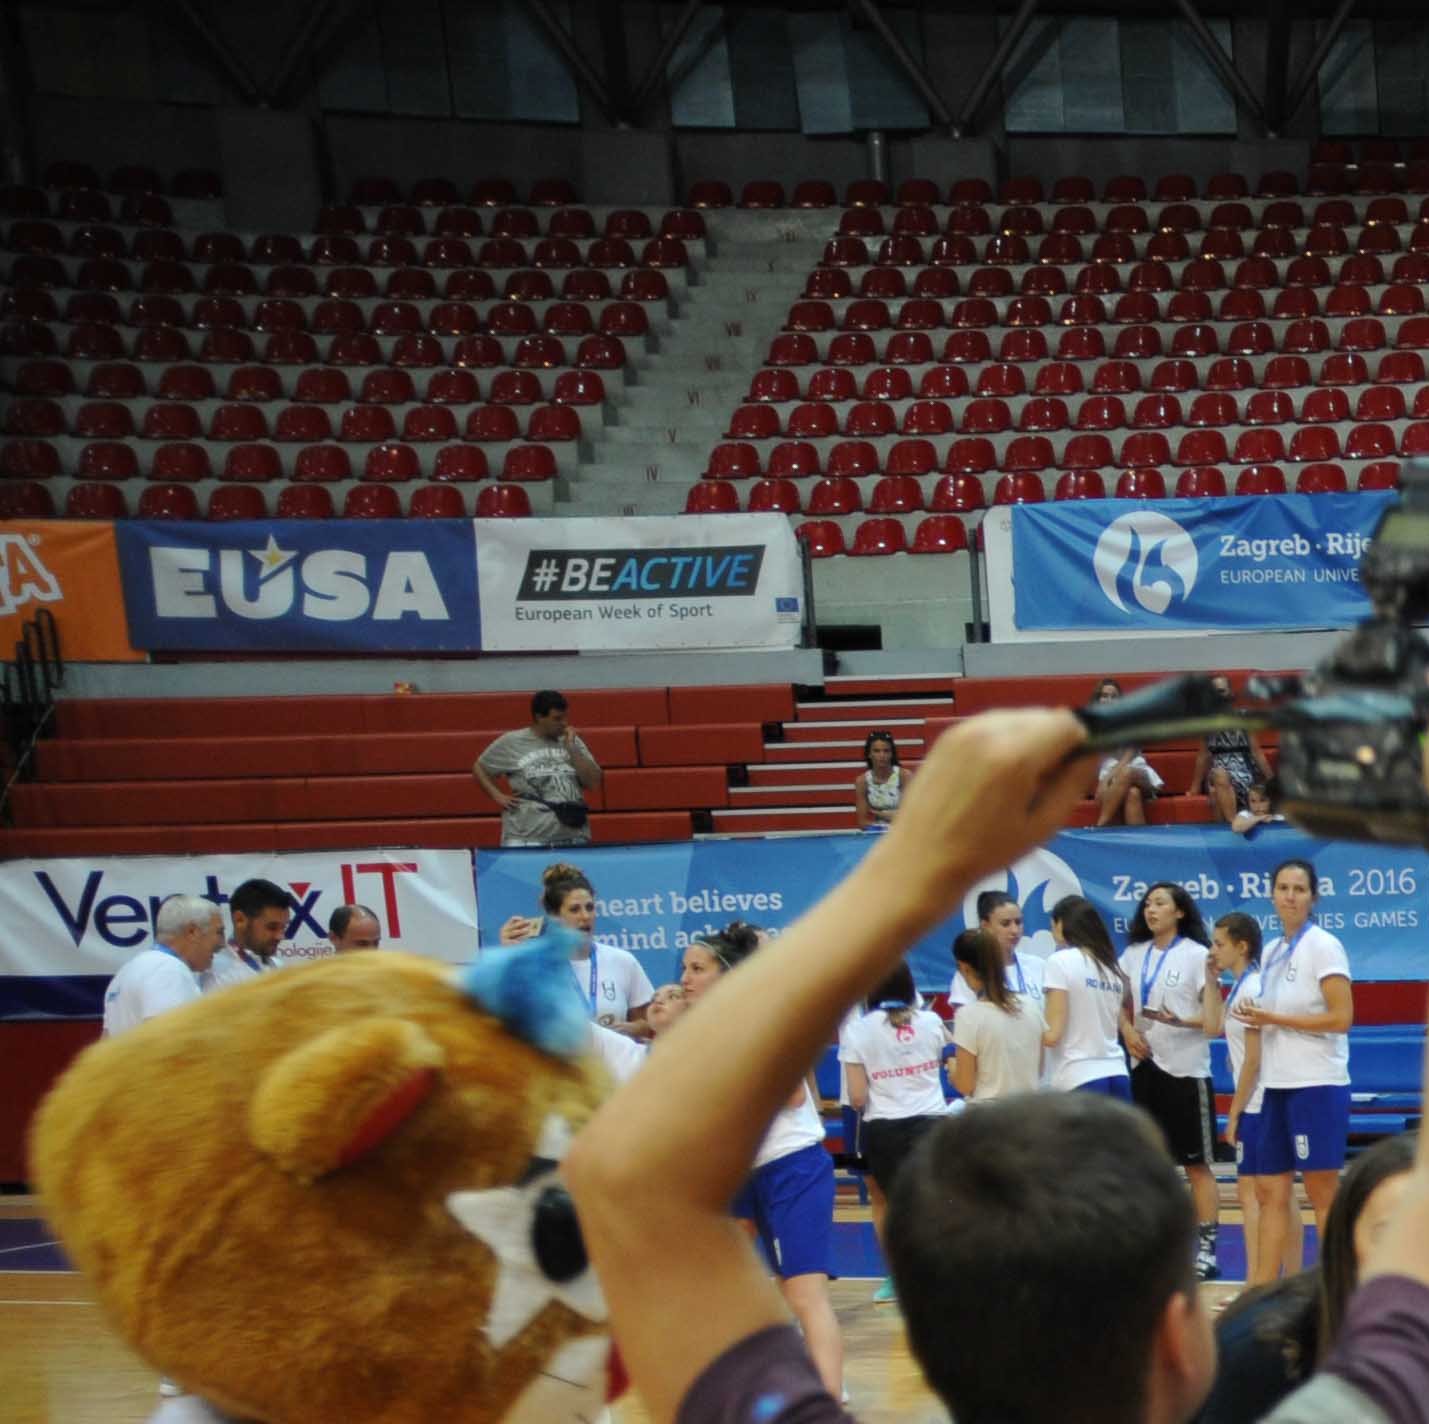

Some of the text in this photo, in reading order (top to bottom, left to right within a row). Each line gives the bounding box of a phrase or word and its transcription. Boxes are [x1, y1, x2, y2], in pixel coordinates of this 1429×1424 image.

[1219, 533, 1310, 560] Zagreb
[148, 546, 450, 621] EUSA
[532, 554, 755, 592] #BEACTIVE
[1220, 569, 1305, 583] EUROPEAN
[515, 603, 713, 623] European Week of Sport
[1349, 868, 1417, 896] 2016
[340, 863, 417, 938] IT
[669, 888, 783, 914] believes
[1354, 910, 1418, 929] GAMES
